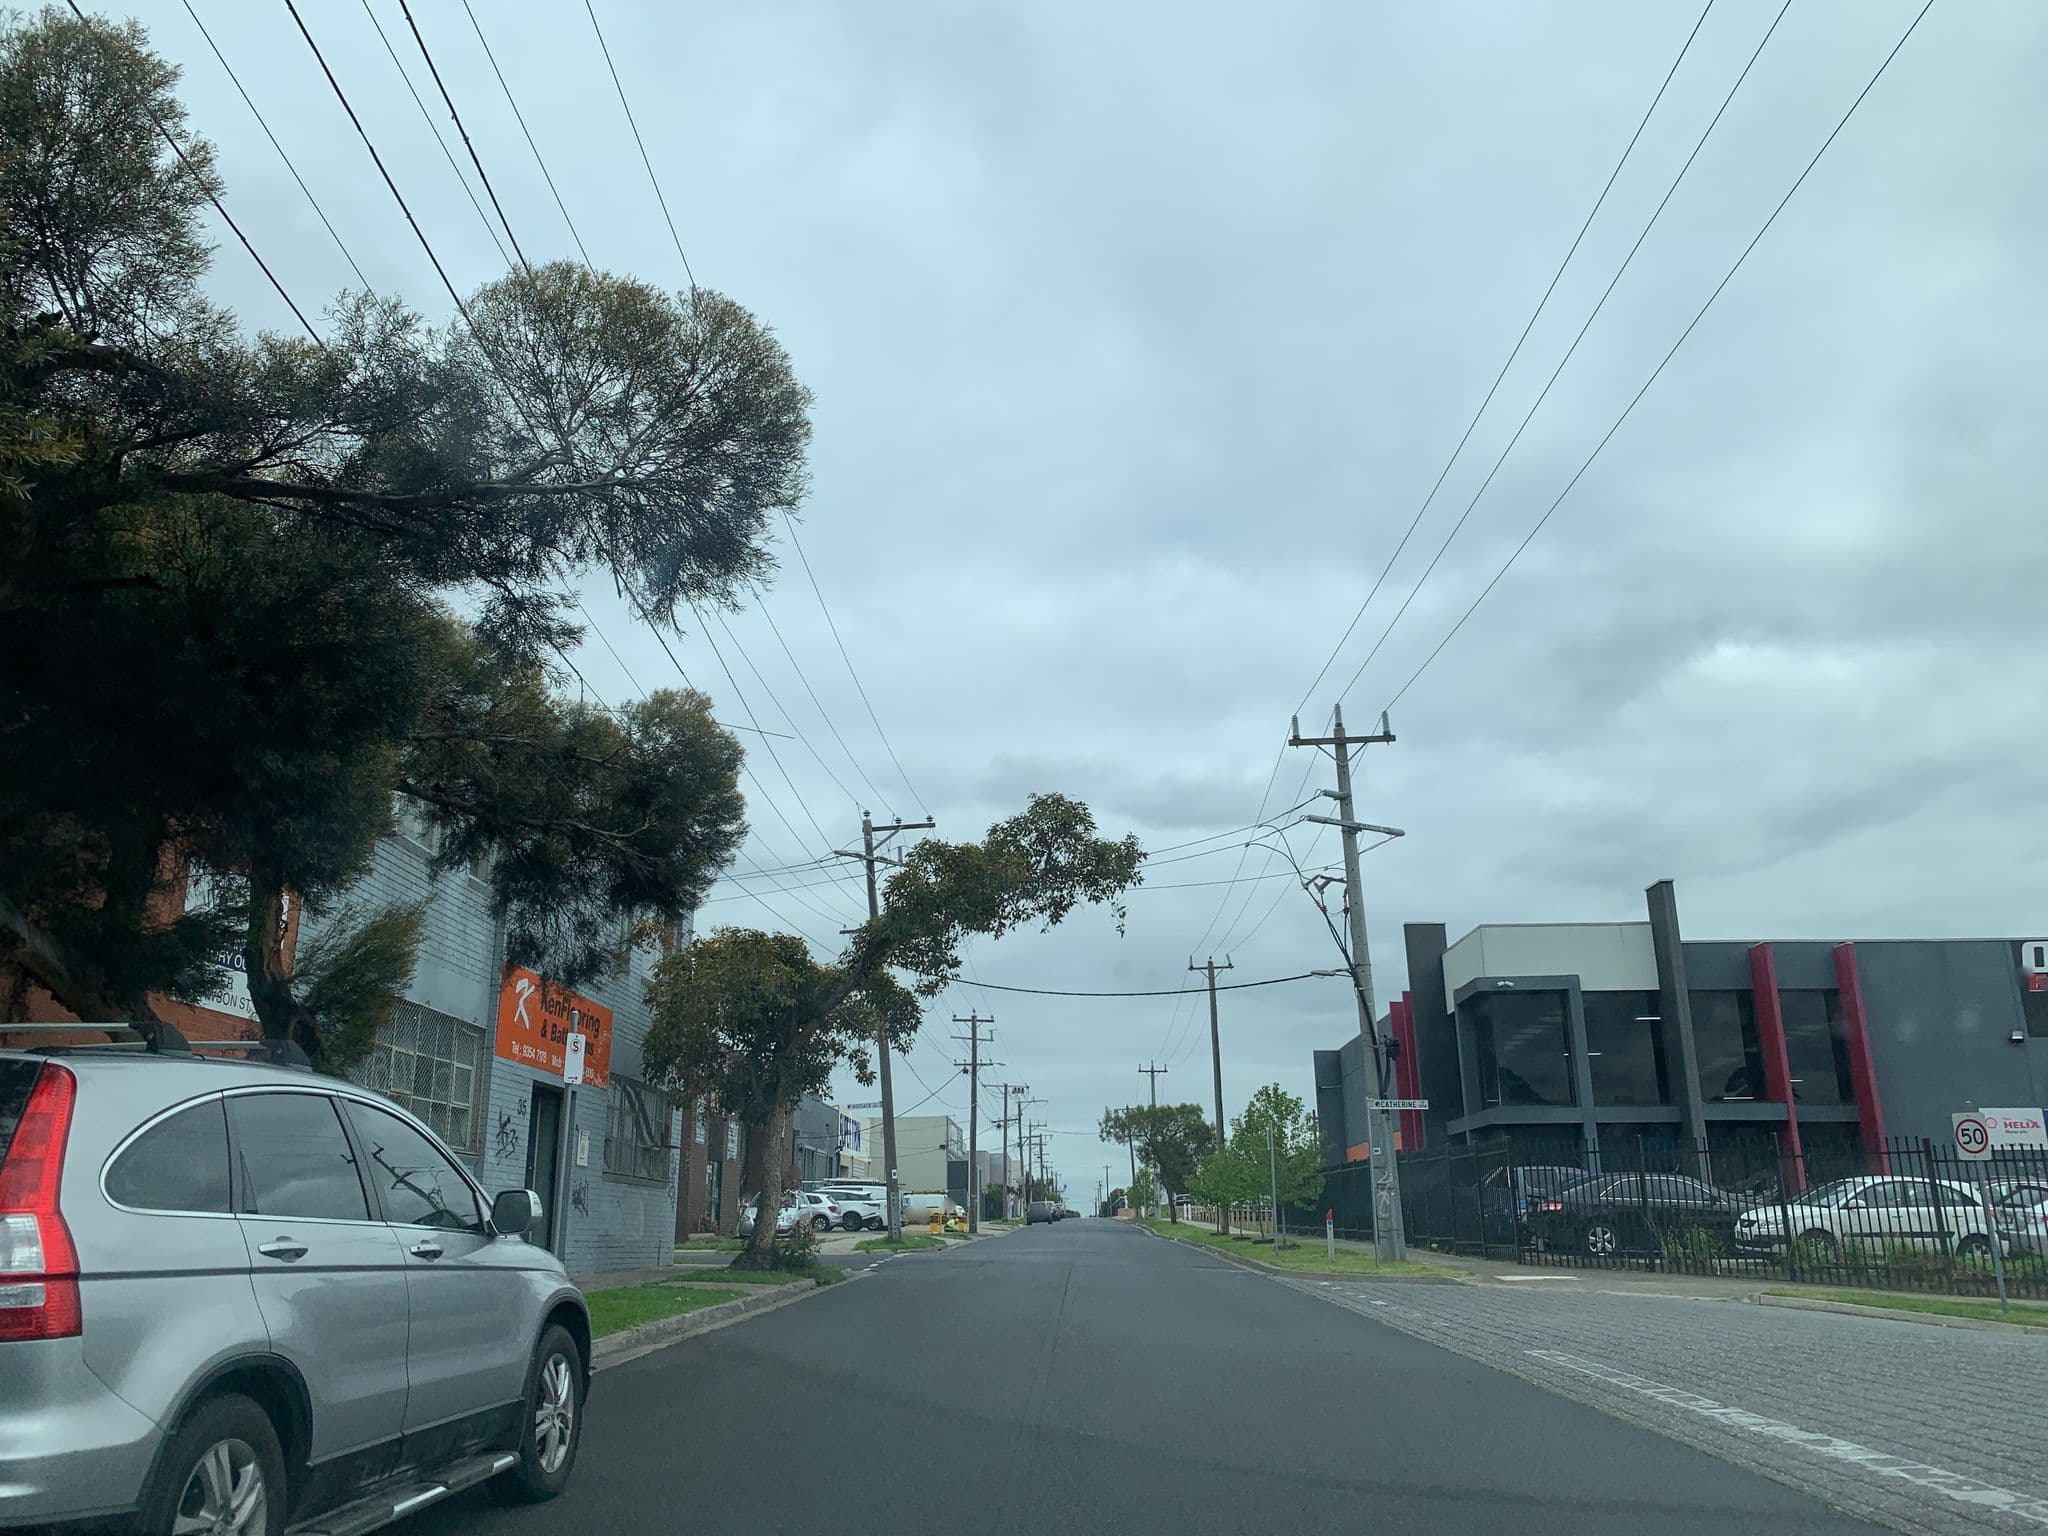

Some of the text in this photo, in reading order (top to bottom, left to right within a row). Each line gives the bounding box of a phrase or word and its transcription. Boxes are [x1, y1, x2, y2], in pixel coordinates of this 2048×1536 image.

[541, 1019, 548, 1039] &
[2003, 1120, 2042, 1129] HELIX
[1961, 1128, 1984, 1145] 50
